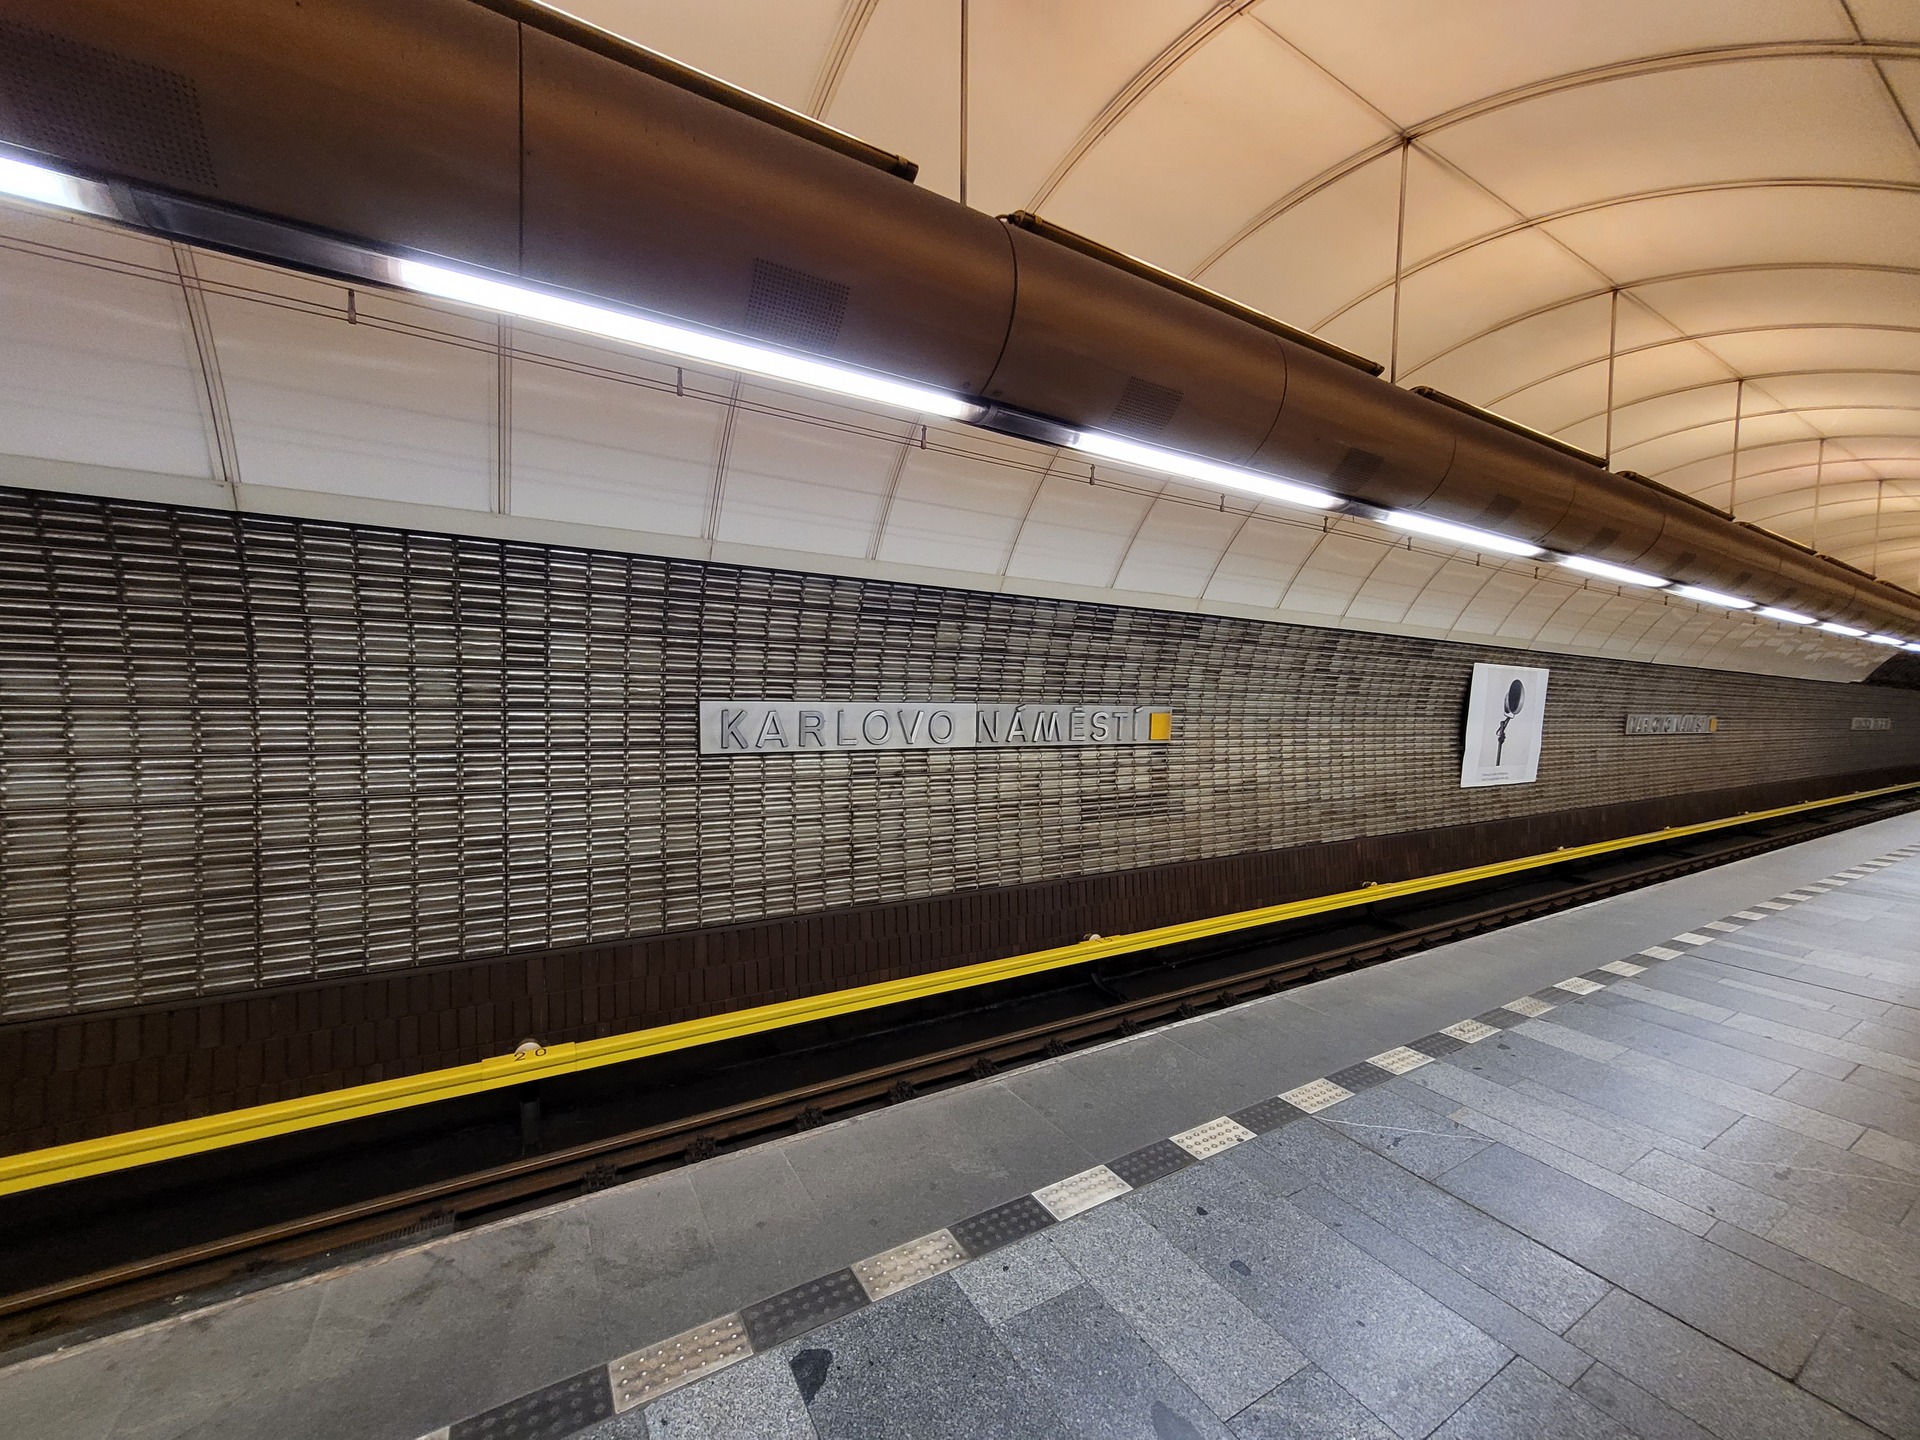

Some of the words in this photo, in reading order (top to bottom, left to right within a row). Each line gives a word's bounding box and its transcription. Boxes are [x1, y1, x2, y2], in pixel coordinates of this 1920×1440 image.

[720, 708, 955, 749] KARLOVO
[976, 704, 1144, 743] NÁMĚSTÍ
[513, 1048, 547, 1062] 20
